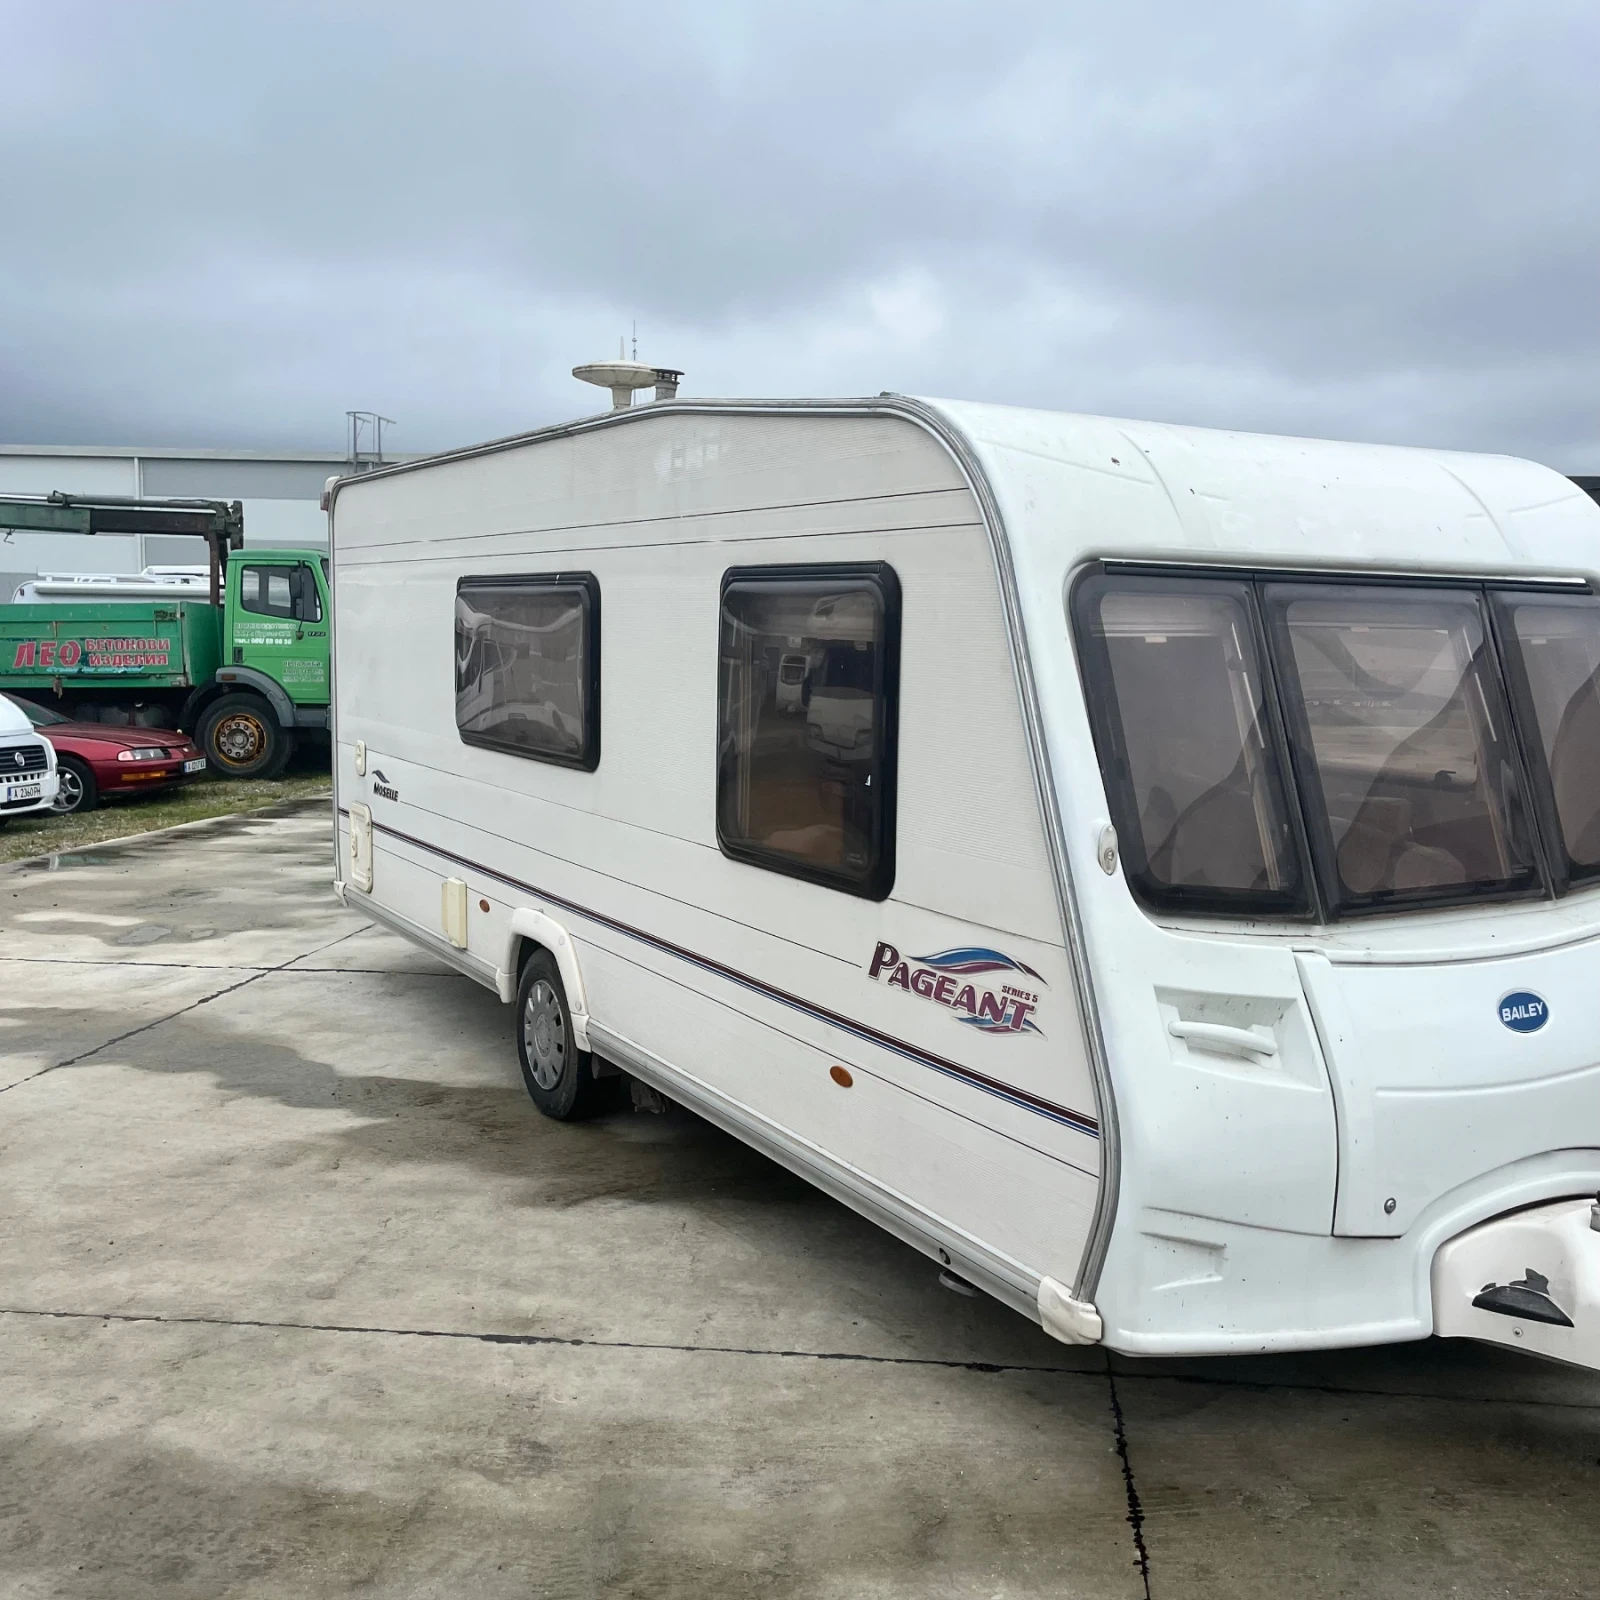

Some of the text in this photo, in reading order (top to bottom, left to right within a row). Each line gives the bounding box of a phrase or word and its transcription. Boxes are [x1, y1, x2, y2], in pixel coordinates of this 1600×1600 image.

[13, 640, 82, 669] ЛЕО
[85, 639, 170, 651] БЕТОНОВИ
[89, 653, 168, 666] ИЗДЕЛИЯ
[373, 781, 399, 802] MOSELLE
[1001, 984, 1039, 1003] SERIES 5
[1501, 1001, 1544, 1022] BAILEY
